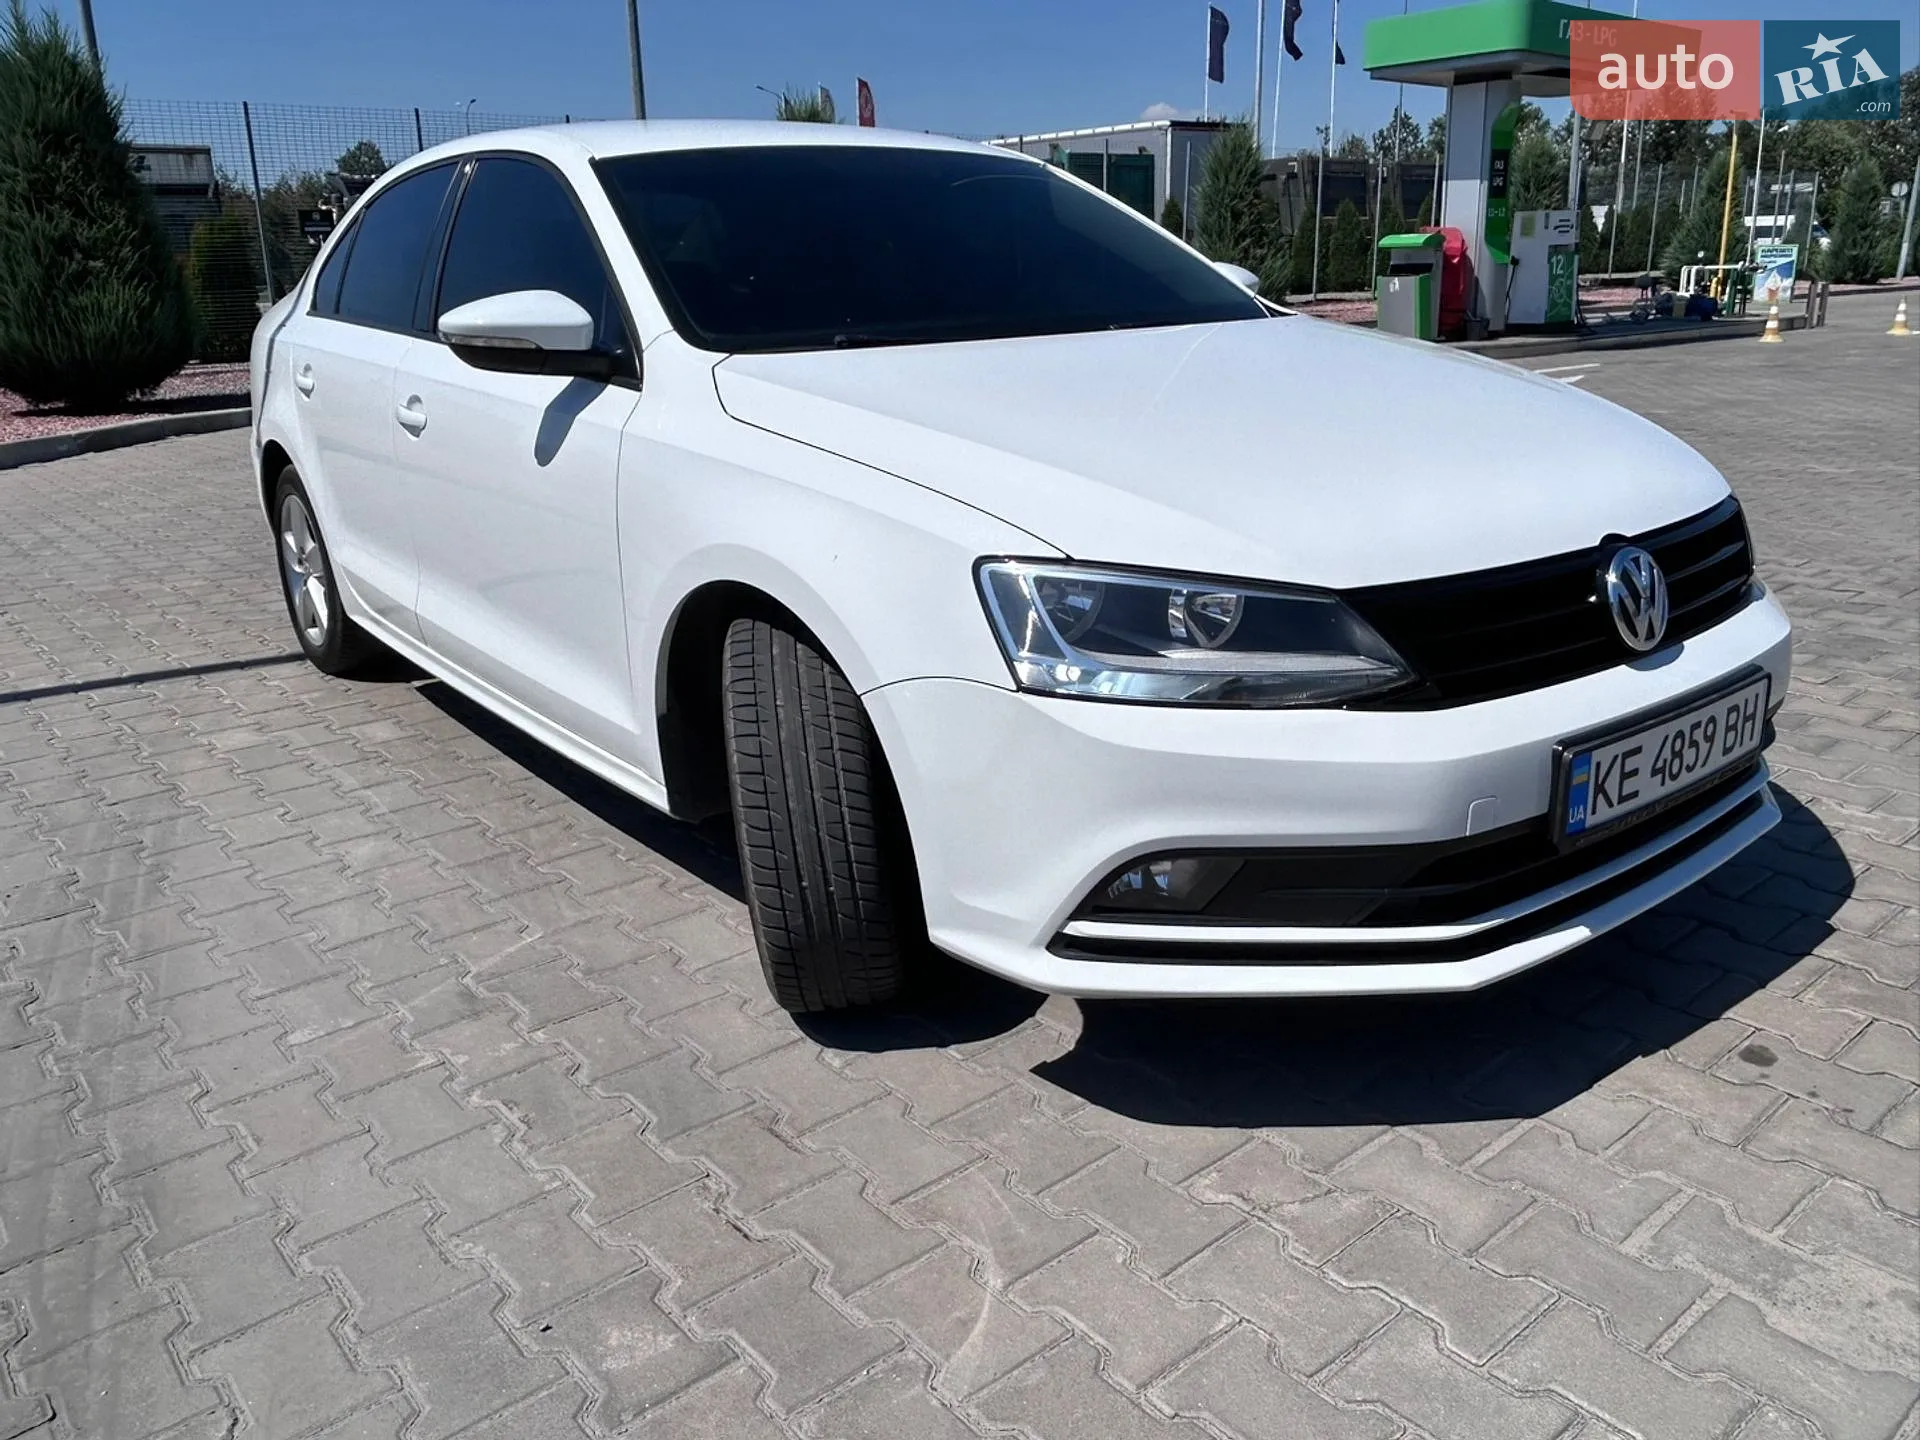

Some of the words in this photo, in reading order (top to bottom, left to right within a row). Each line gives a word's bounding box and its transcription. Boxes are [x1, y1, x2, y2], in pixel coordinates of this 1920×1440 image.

[1551, 255, 1564, 275] 12
[1591, 744, 1643, 816] KE
[1650, 715, 1717, 787] 4859
[1722, 692, 1760, 758] BH
[1568, 805, 1585, 824] UA
